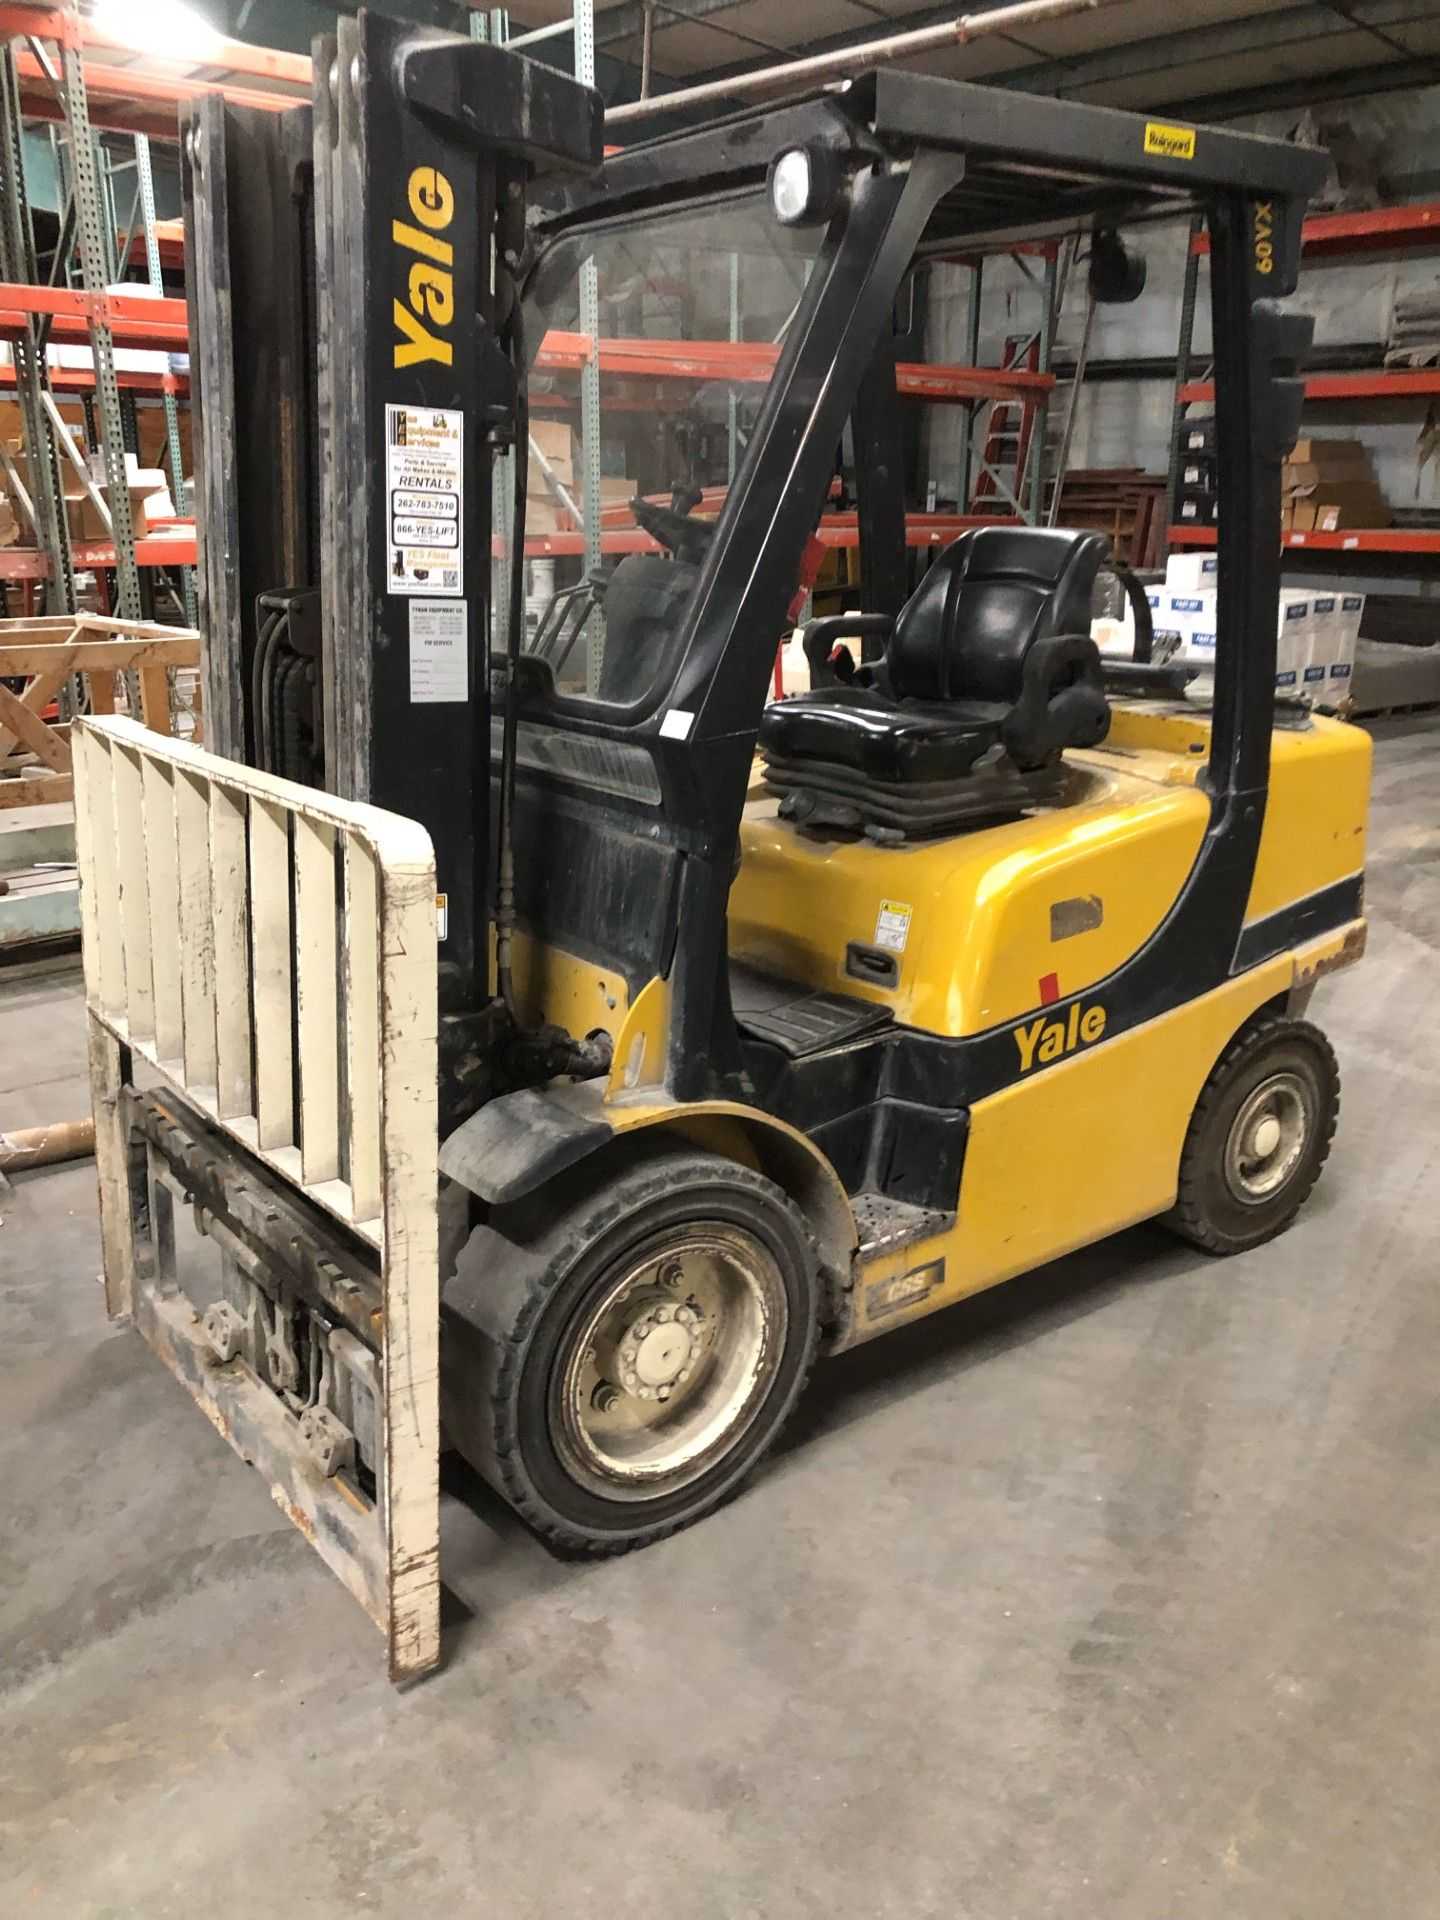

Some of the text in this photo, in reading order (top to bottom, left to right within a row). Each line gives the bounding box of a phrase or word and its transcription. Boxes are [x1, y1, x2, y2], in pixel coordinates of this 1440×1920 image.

[392, 166, 454, 369] Yale
[1255, 201, 1273, 274] 60VX
[399, 475, 453, 489] RENTALS
[396, 524, 455, 536] 866-YES-LIFT
[1013, 1002, 1107, 1073] Yale
